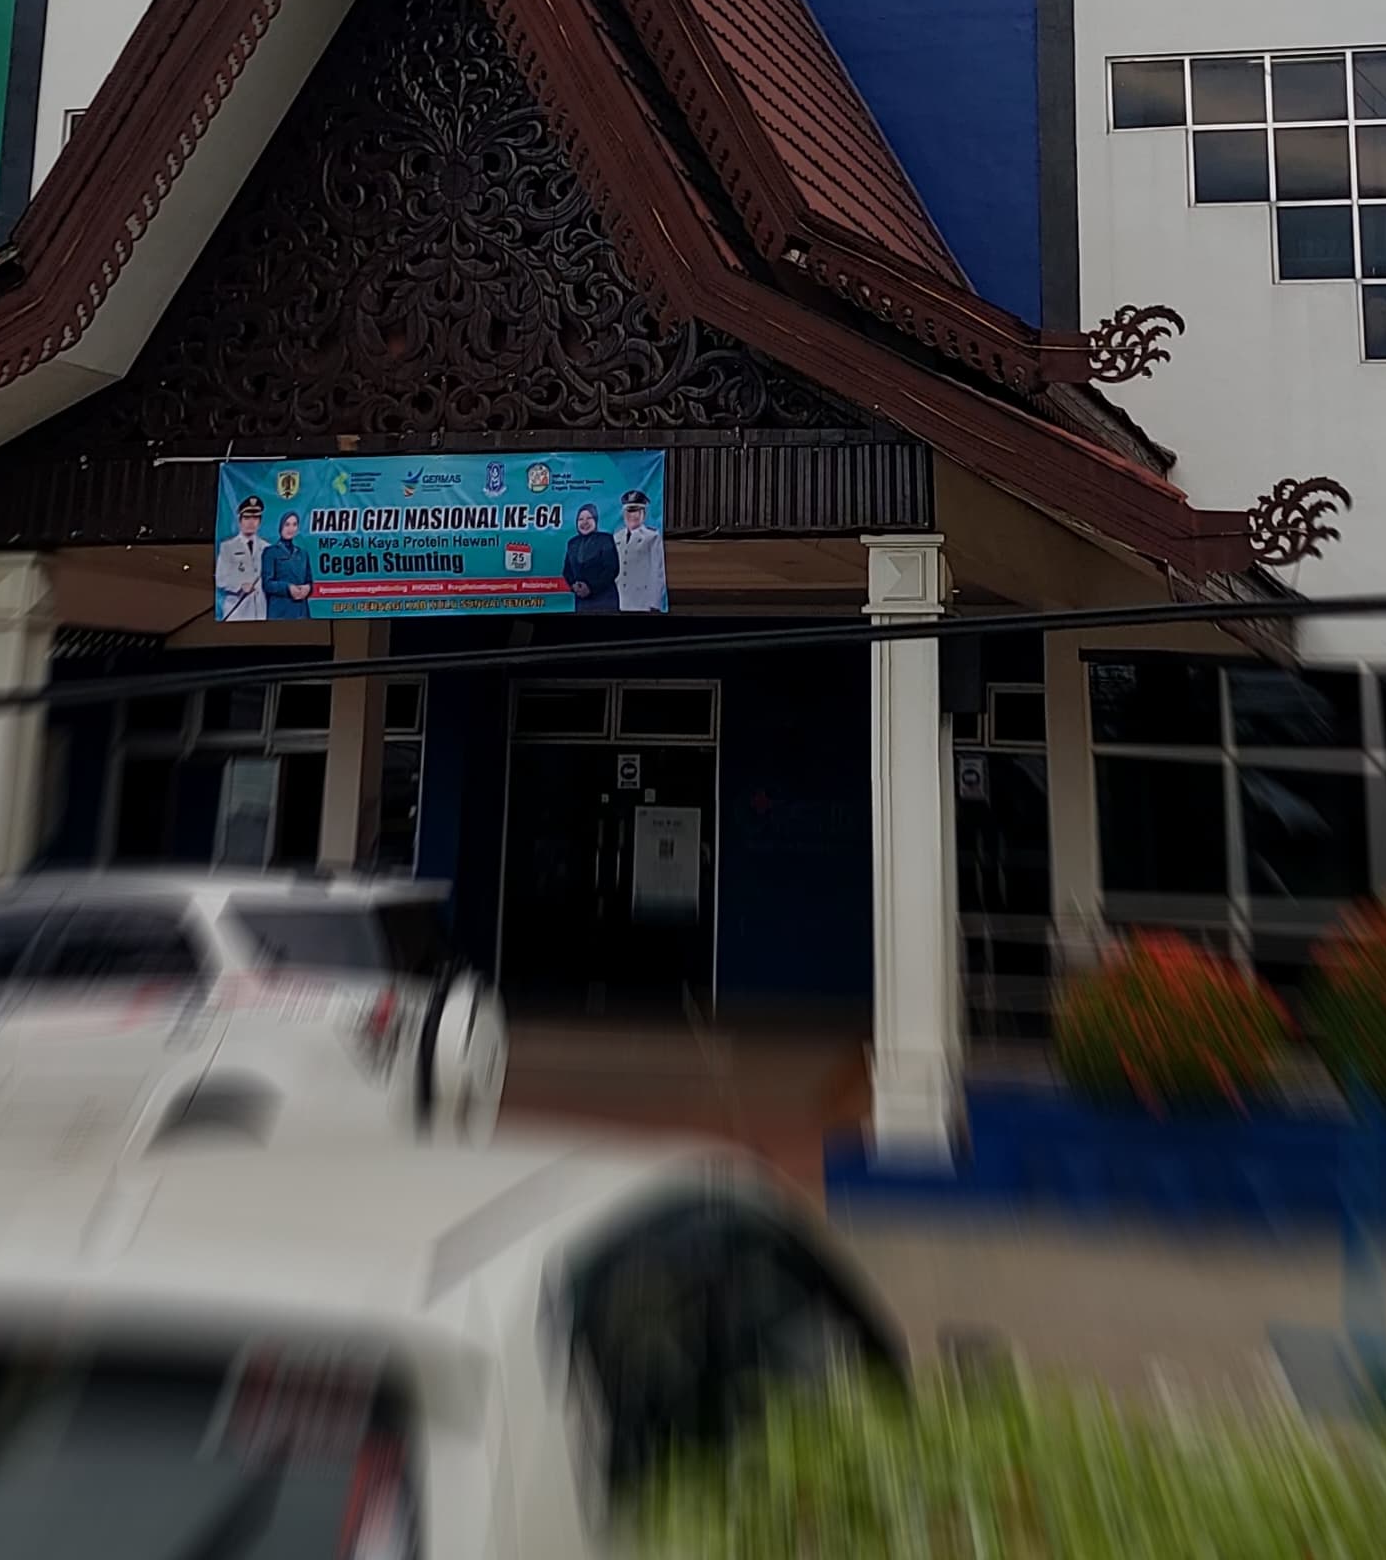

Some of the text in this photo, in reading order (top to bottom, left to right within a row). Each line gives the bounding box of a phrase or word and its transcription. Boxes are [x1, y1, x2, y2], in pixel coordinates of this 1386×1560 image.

[310, 505, 562, 532] HARI GIZI NASIONAL KE-64
[318, 534, 500, 551] MP-ASI Kaya Protein Hewani
[319, 550, 464, 576] Cegah Stunting
[512, 552, 525, 562] 25
